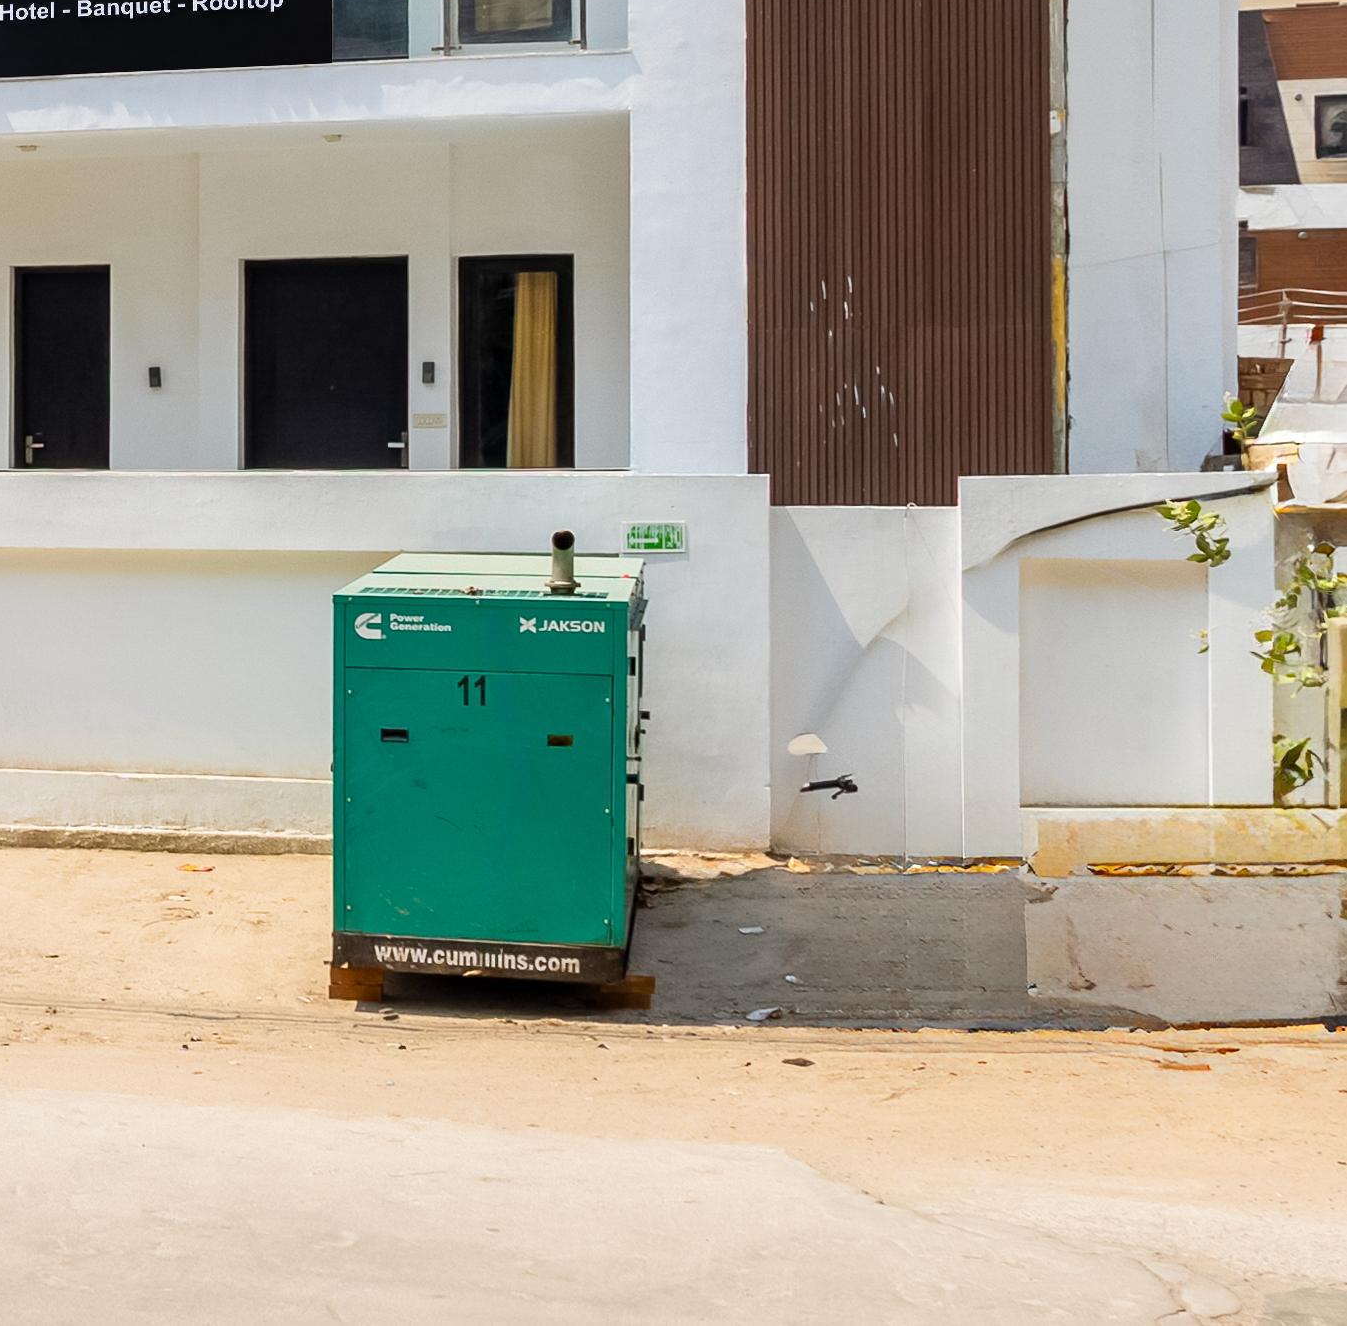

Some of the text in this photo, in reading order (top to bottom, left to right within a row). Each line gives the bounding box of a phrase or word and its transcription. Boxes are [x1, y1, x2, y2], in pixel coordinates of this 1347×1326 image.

[0, 1, 55, 21] Hotel
[389, 613, 425, 623] Power
[389, 622, 452, 632] Generation
[538, 619, 605, 634] JAKSON
[457, 675, 486, 707] 11
